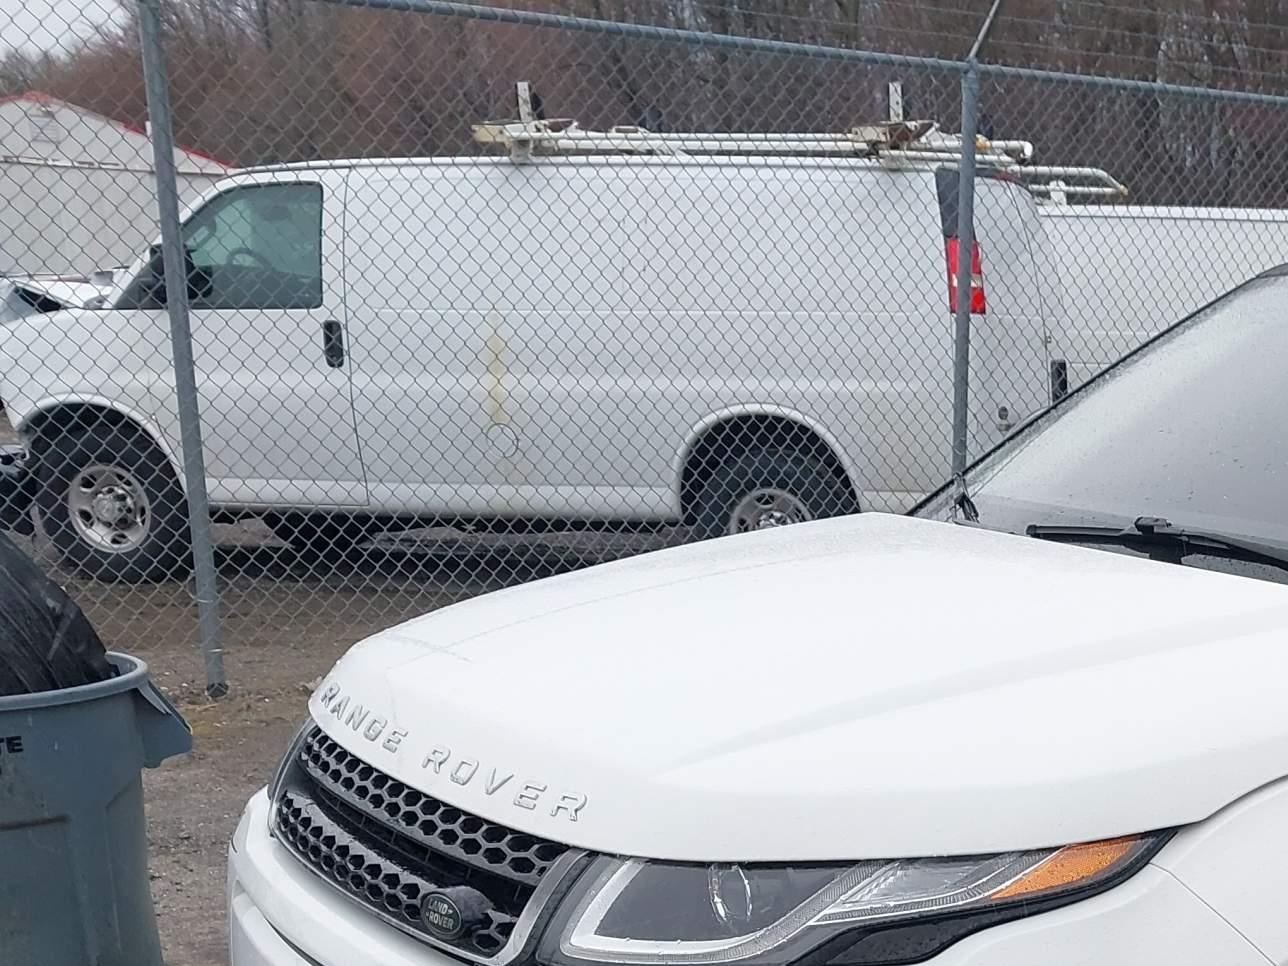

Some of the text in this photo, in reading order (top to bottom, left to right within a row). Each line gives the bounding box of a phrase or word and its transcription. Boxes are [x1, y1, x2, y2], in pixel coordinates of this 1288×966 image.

[320, 681, 589, 822] RANGE ROVER
[428, 898, 449, 915] LAND
[428, 911, 454, 930] ROVER
